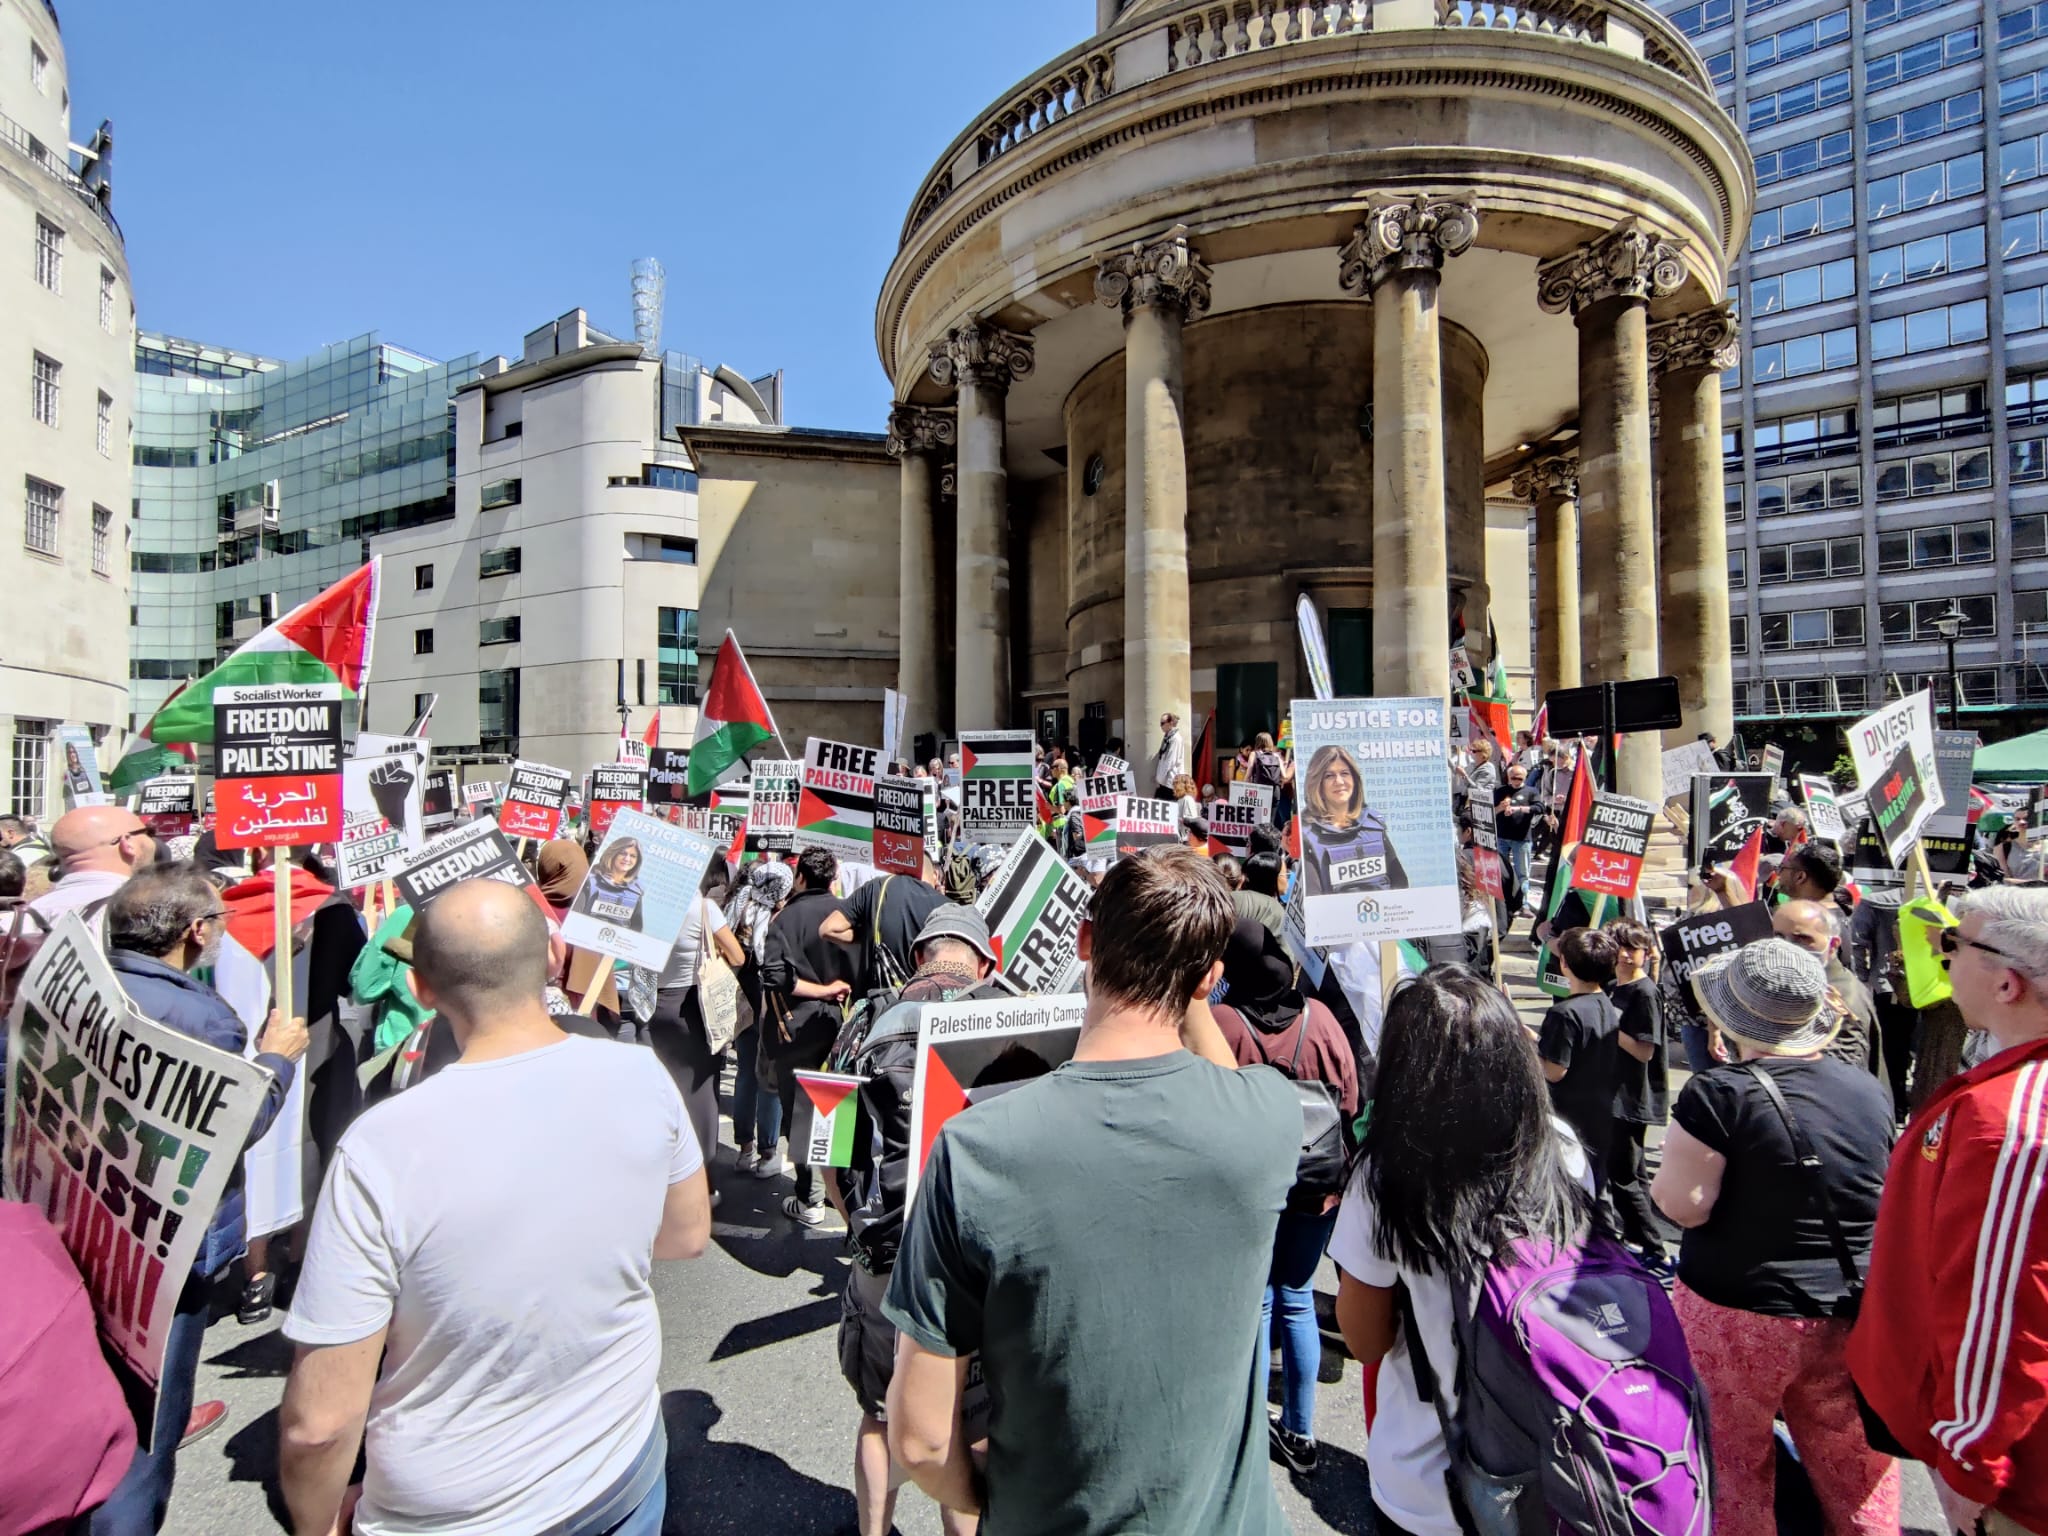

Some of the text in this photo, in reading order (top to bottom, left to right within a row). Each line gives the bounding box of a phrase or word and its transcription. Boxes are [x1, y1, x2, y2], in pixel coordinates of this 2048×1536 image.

[234, 689, 323, 701] Socialist Worker
[227, 706, 328, 734] FREEDOM
[1309, 709, 1439, 730] JUSTICE FOR
[270, 733, 288, 745] for
[1864, 705, 1915, 757] DIVEST
[1944, 736, 1973, 744] FOR
[626, 740, 645, 757] FREE
[1358, 740, 1441, 759] SHIREEN
[1937, 750, 1972, 758] REEN
[223, 745, 337, 773] PALESTINE
[817, 742, 877, 777] FREE
[1102, 755, 1124, 769] FREE
[597, 772, 639, 785] FREEDOM
[650, 768, 689, 784] Palest
[755, 763, 800, 777] FREE PALEST
[1387, 765, 1431, 774] PALESTINE
[468, 783, 488, 794] FREE
[516, 771, 564, 791] FREEDOM
[805, 767, 874, 795] PALESTIN
[1085, 774, 1127, 796] FREE
[1387, 777, 1431, 785] PALESTINE
[145, 786, 190, 797] FREEDOM
[242, 782, 317, 808] الحرية
[509, 787, 562, 808] PALESTINE
[594, 788, 642, 800] PALESTINE
[878, 788, 919, 809] FREEDOM
[963, 780, 1033, 807] FREE
[1388, 788, 1432, 797] PALESTINE
[141, 801, 190, 813] PALESTINE
[514, 805, 548, 819] الحرية
[1082, 794, 1126, 811] PALEST
[1127, 798, 1170, 822] FREE
[1604, 795, 1649, 810] Socialist Worker
[233, 806, 328, 835] لفلسطين
[688, 812, 708, 829] RET
[876, 811, 921, 834] PALESTINE
[963, 808, 1033, 820] PALESTINE
[1216, 804, 1255, 824] FREE
[1593, 805, 1649, 831] FREEDOM
[625, 817, 710, 856] JUSTICE FOR
[708, 831, 734, 841] PALES
[1120, 819, 1175, 834] PALESTINE
[345, 836, 400, 861] RESIST.
[403, 826, 481, 867] Socialist Worker
[1584, 828, 1646, 855] PALESTINE
[406, 837, 503, 896] FREEDOM
[647, 844, 705, 870] SHIREEN
[1590, 851, 1630, 871] الحرية
[985, 833, 1034, 907] Solidarity Campaign
[1338, 859, 1382, 880] PRESS
[1580, 869, 1630, 887] لفلسطين
[597, 903, 631, 917] PRESS
[1005, 872, 1086, 992] FREE
[1678, 920, 1734, 952] Free
[1545, 974, 1558, 984] FOA
[930, 1006, 1086, 1035] Palestine Solidarity Campa
[35, 936, 239, 1139] FREE PALESTINE
[20, 999, 212, 1207] EXIST!
[17, 1060, 183, 1260] RESIST!
[811, 1138, 829, 1163] FOA
